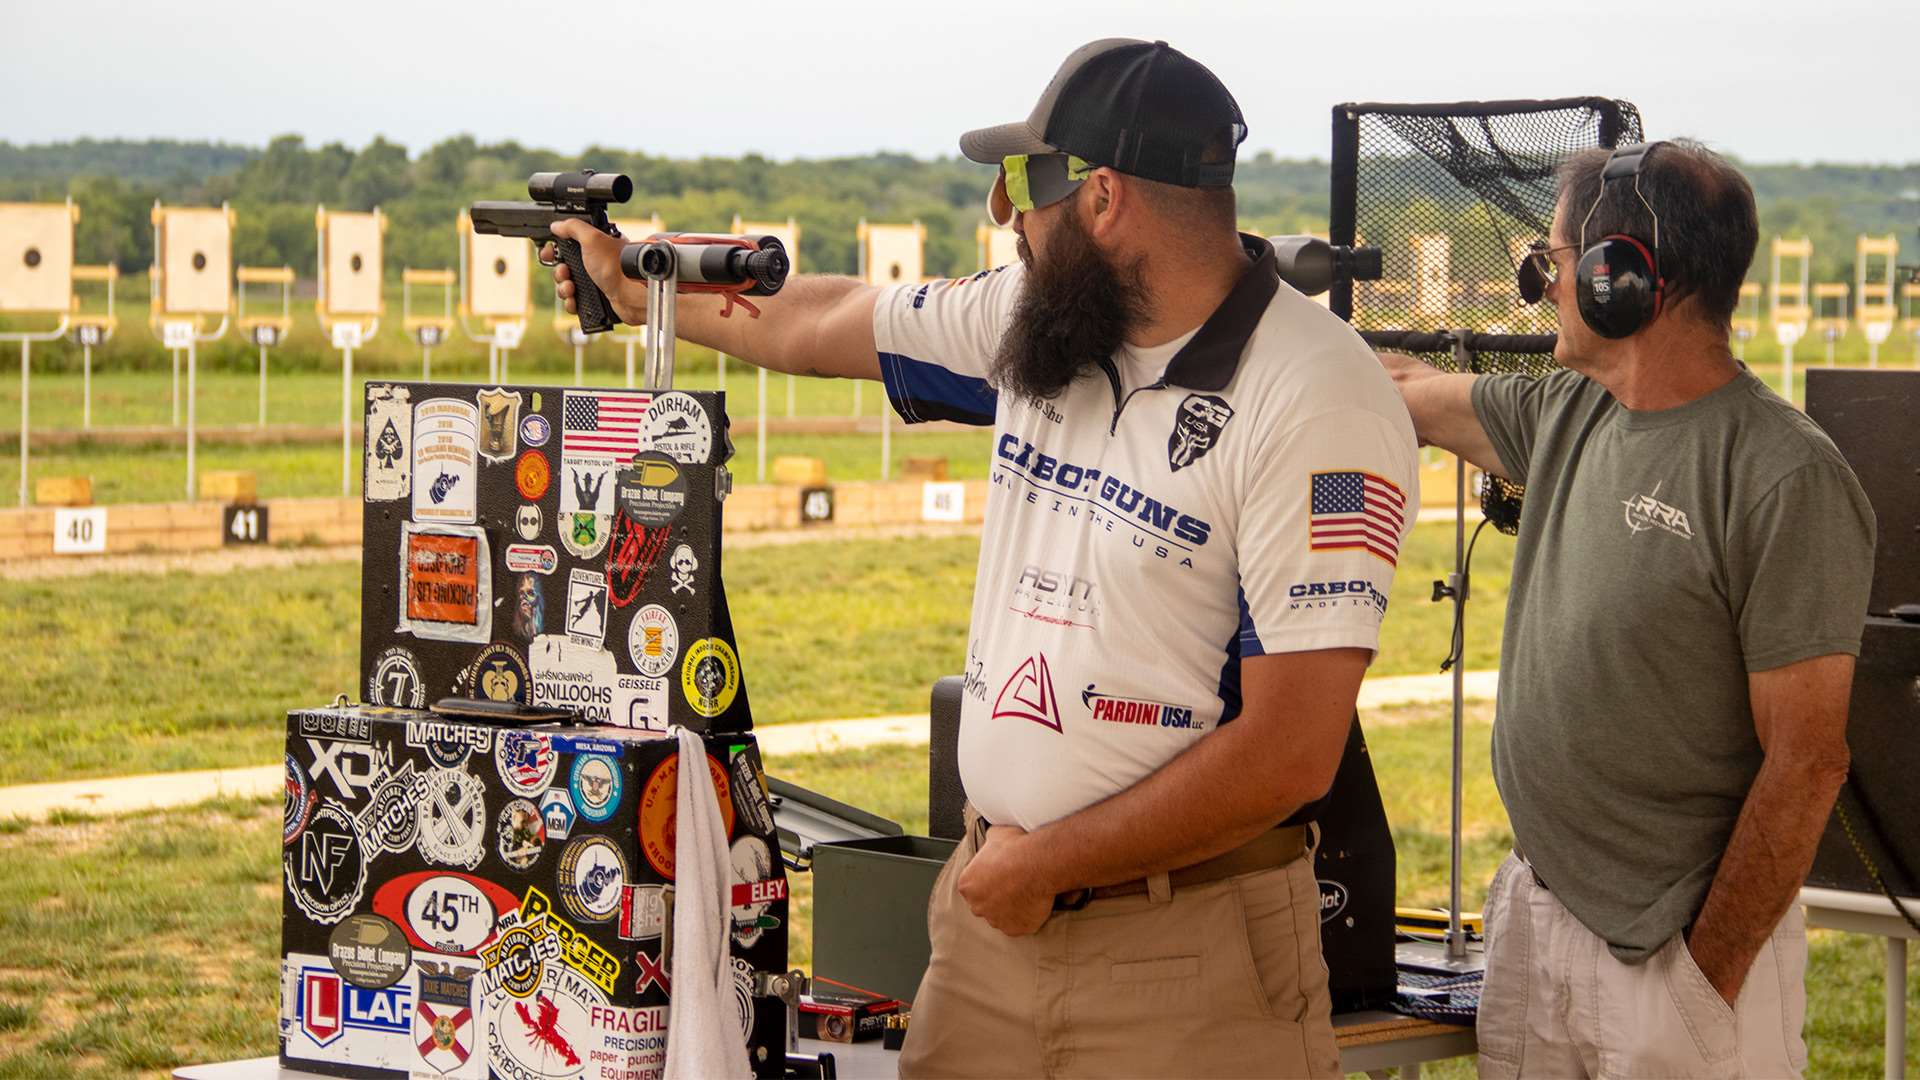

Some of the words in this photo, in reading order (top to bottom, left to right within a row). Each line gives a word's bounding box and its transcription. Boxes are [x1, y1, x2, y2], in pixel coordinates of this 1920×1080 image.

[648, 397, 701, 423] DURHAM
[1100, 475, 1211, 546] GUNS
[1636, 494, 1692, 536] RRA
[67, 518, 94, 543] 40
[230, 510, 258, 540] 41
[1052, 500, 1078, 517] IN
[1089, 509, 1113, 532] THE
[1132, 533, 1193, 569] USA
[572, 572, 604, 583] ADVENTURE
[434, 582, 474, 605] PACKING
[1290, 600, 1338, 610] MADE
[1353, 599, 1371, 608] IN
[641, 610, 667, 624] FAIRFAX
[570, 635, 595, 648] BREWING
[535, 681, 612, 704] SHOOTING
[618, 678, 661, 691] GEISSELE
[1093, 698, 1160, 725] PARDINI
[1161, 706, 1192, 728] USA
[1192, 721, 1204, 729] LLC
[408, 722, 489, 752] MATCHES
[370, 770, 388, 792] NRA
[360, 776, 430, 858] MATCHES
[547, 816, 566, 832] MGM
[302, 831, 353, 896] NF
[751, 880, 785, 902] ELEY
[499, 913, 518, 931] NRA
[604, 1035, 665, 1052] PRECISION
[590, 1050, 618, 1063] paper
